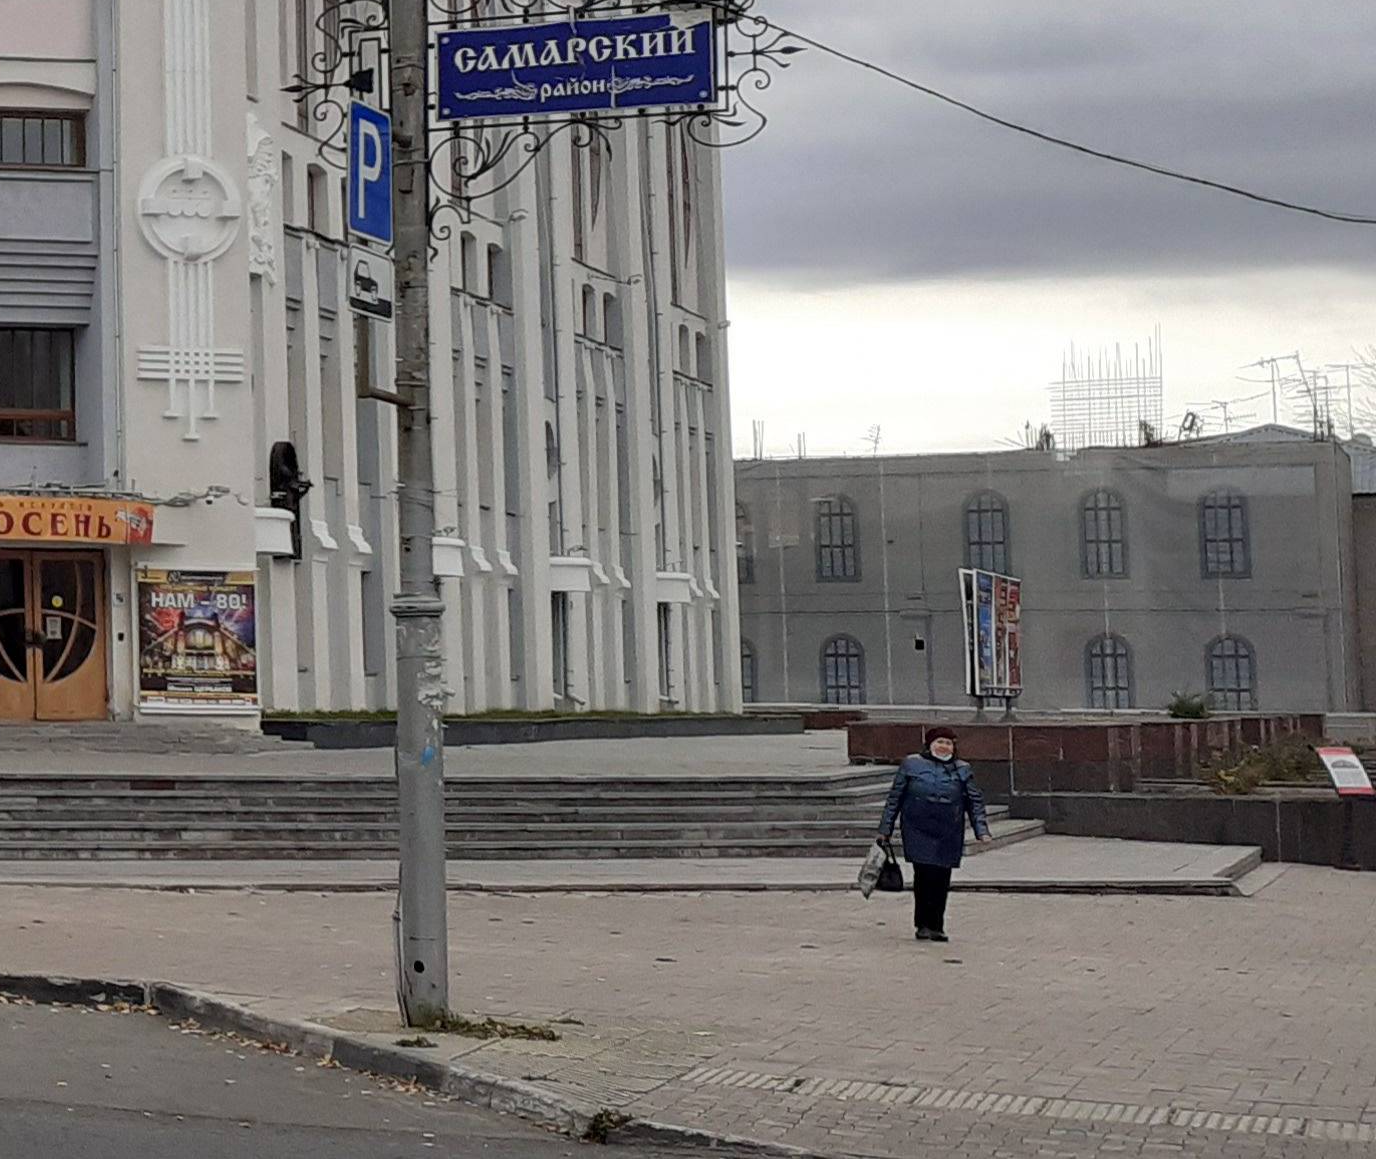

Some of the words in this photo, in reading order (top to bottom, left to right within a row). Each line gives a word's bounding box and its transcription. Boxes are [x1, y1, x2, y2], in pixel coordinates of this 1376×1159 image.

[540, 76, 606, 103] район
[151, 591, 195, 608] НАМ
[216, 593, 247, 609] 80!
